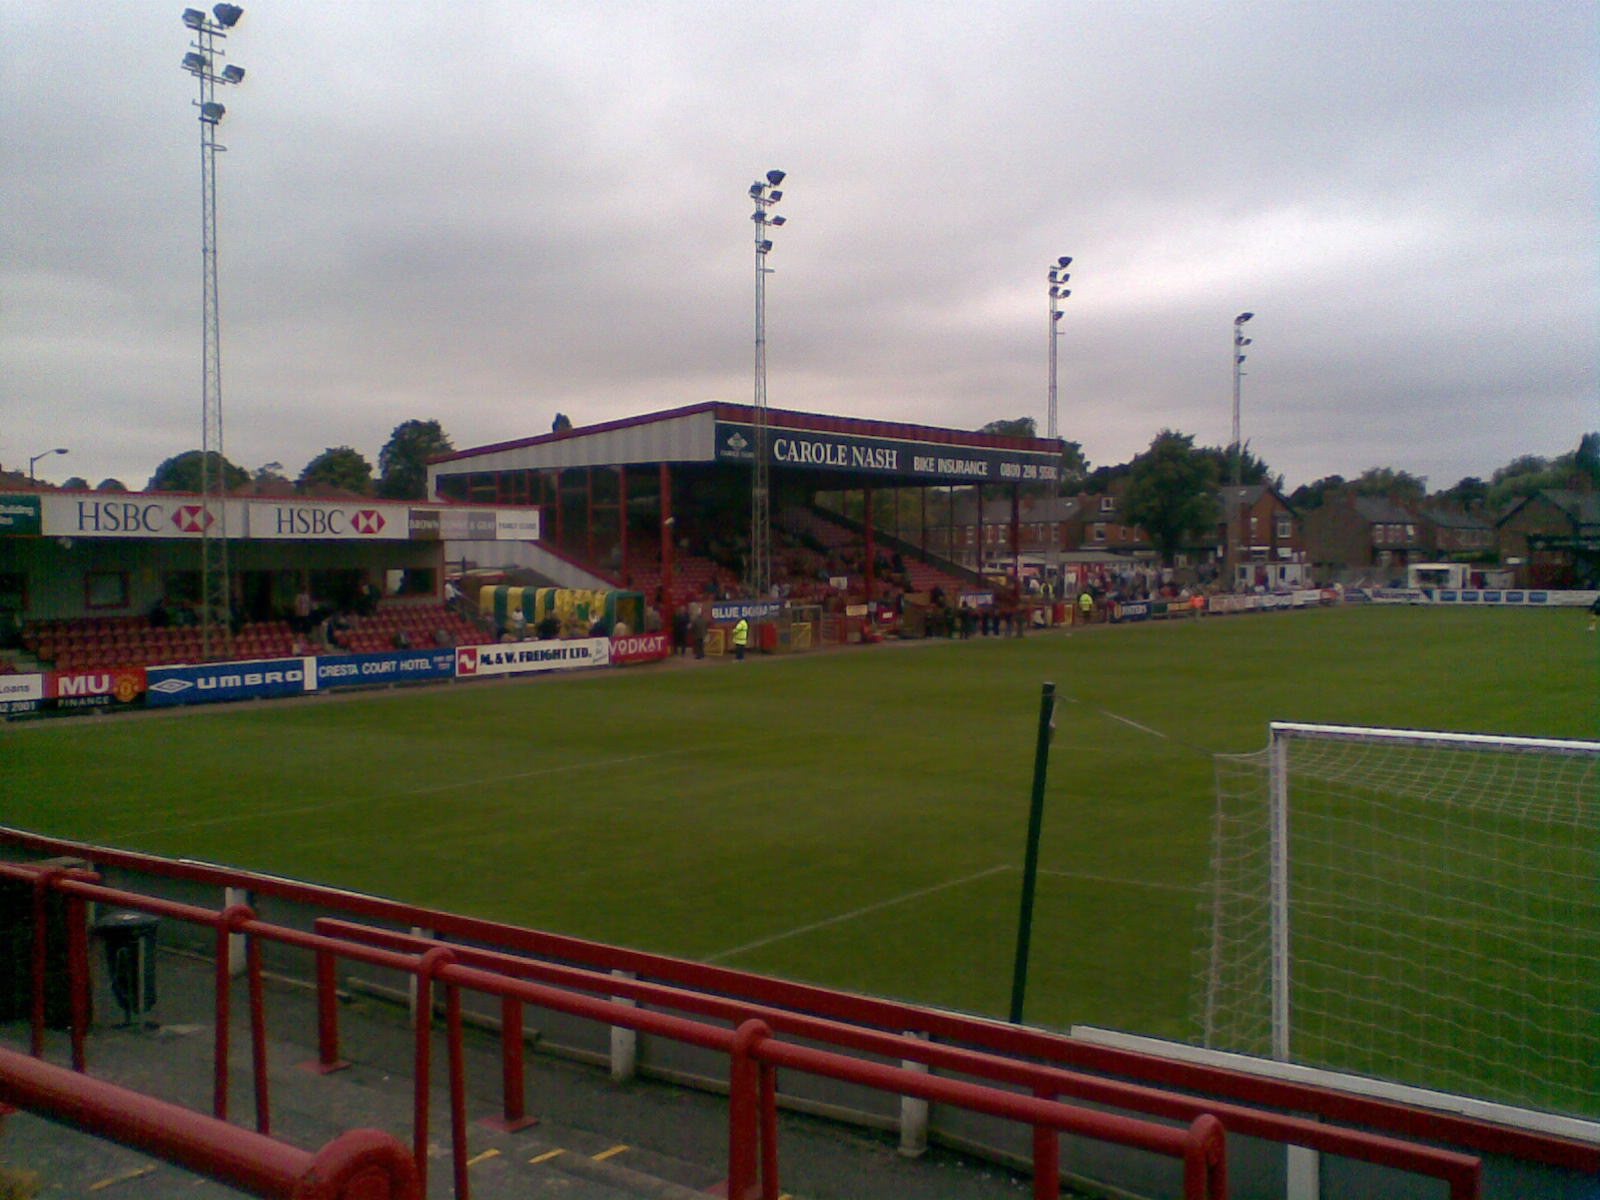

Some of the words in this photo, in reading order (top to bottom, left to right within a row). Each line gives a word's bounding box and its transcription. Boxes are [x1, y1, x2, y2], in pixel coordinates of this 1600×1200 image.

[774, 438, 848, 466] CAROLE
[852, 445, 898, 470] NASH
[914, 455, 935, 473] BIKE
[938, 457, 988, 476] INSURANCE
[77, 500, 163, 532] HSBC
[277, 507, 345, 534] HSBC
[711, 606, 739, 619] BLUE
[495, 652, 503, 664] &
[519, 648, 566, 662] FREIGHT
[569, 647, 591, 659] LTD.
[608, 635, 665, 656] VODKAT
[319, 663, 359, 678] CRESTA
[362, 660, 397, 675] COURT
[400, 658, 432, 671] HOTEL
[58, 674, 110, 696] MU
[58, 695, 110, 708] FINANCE
